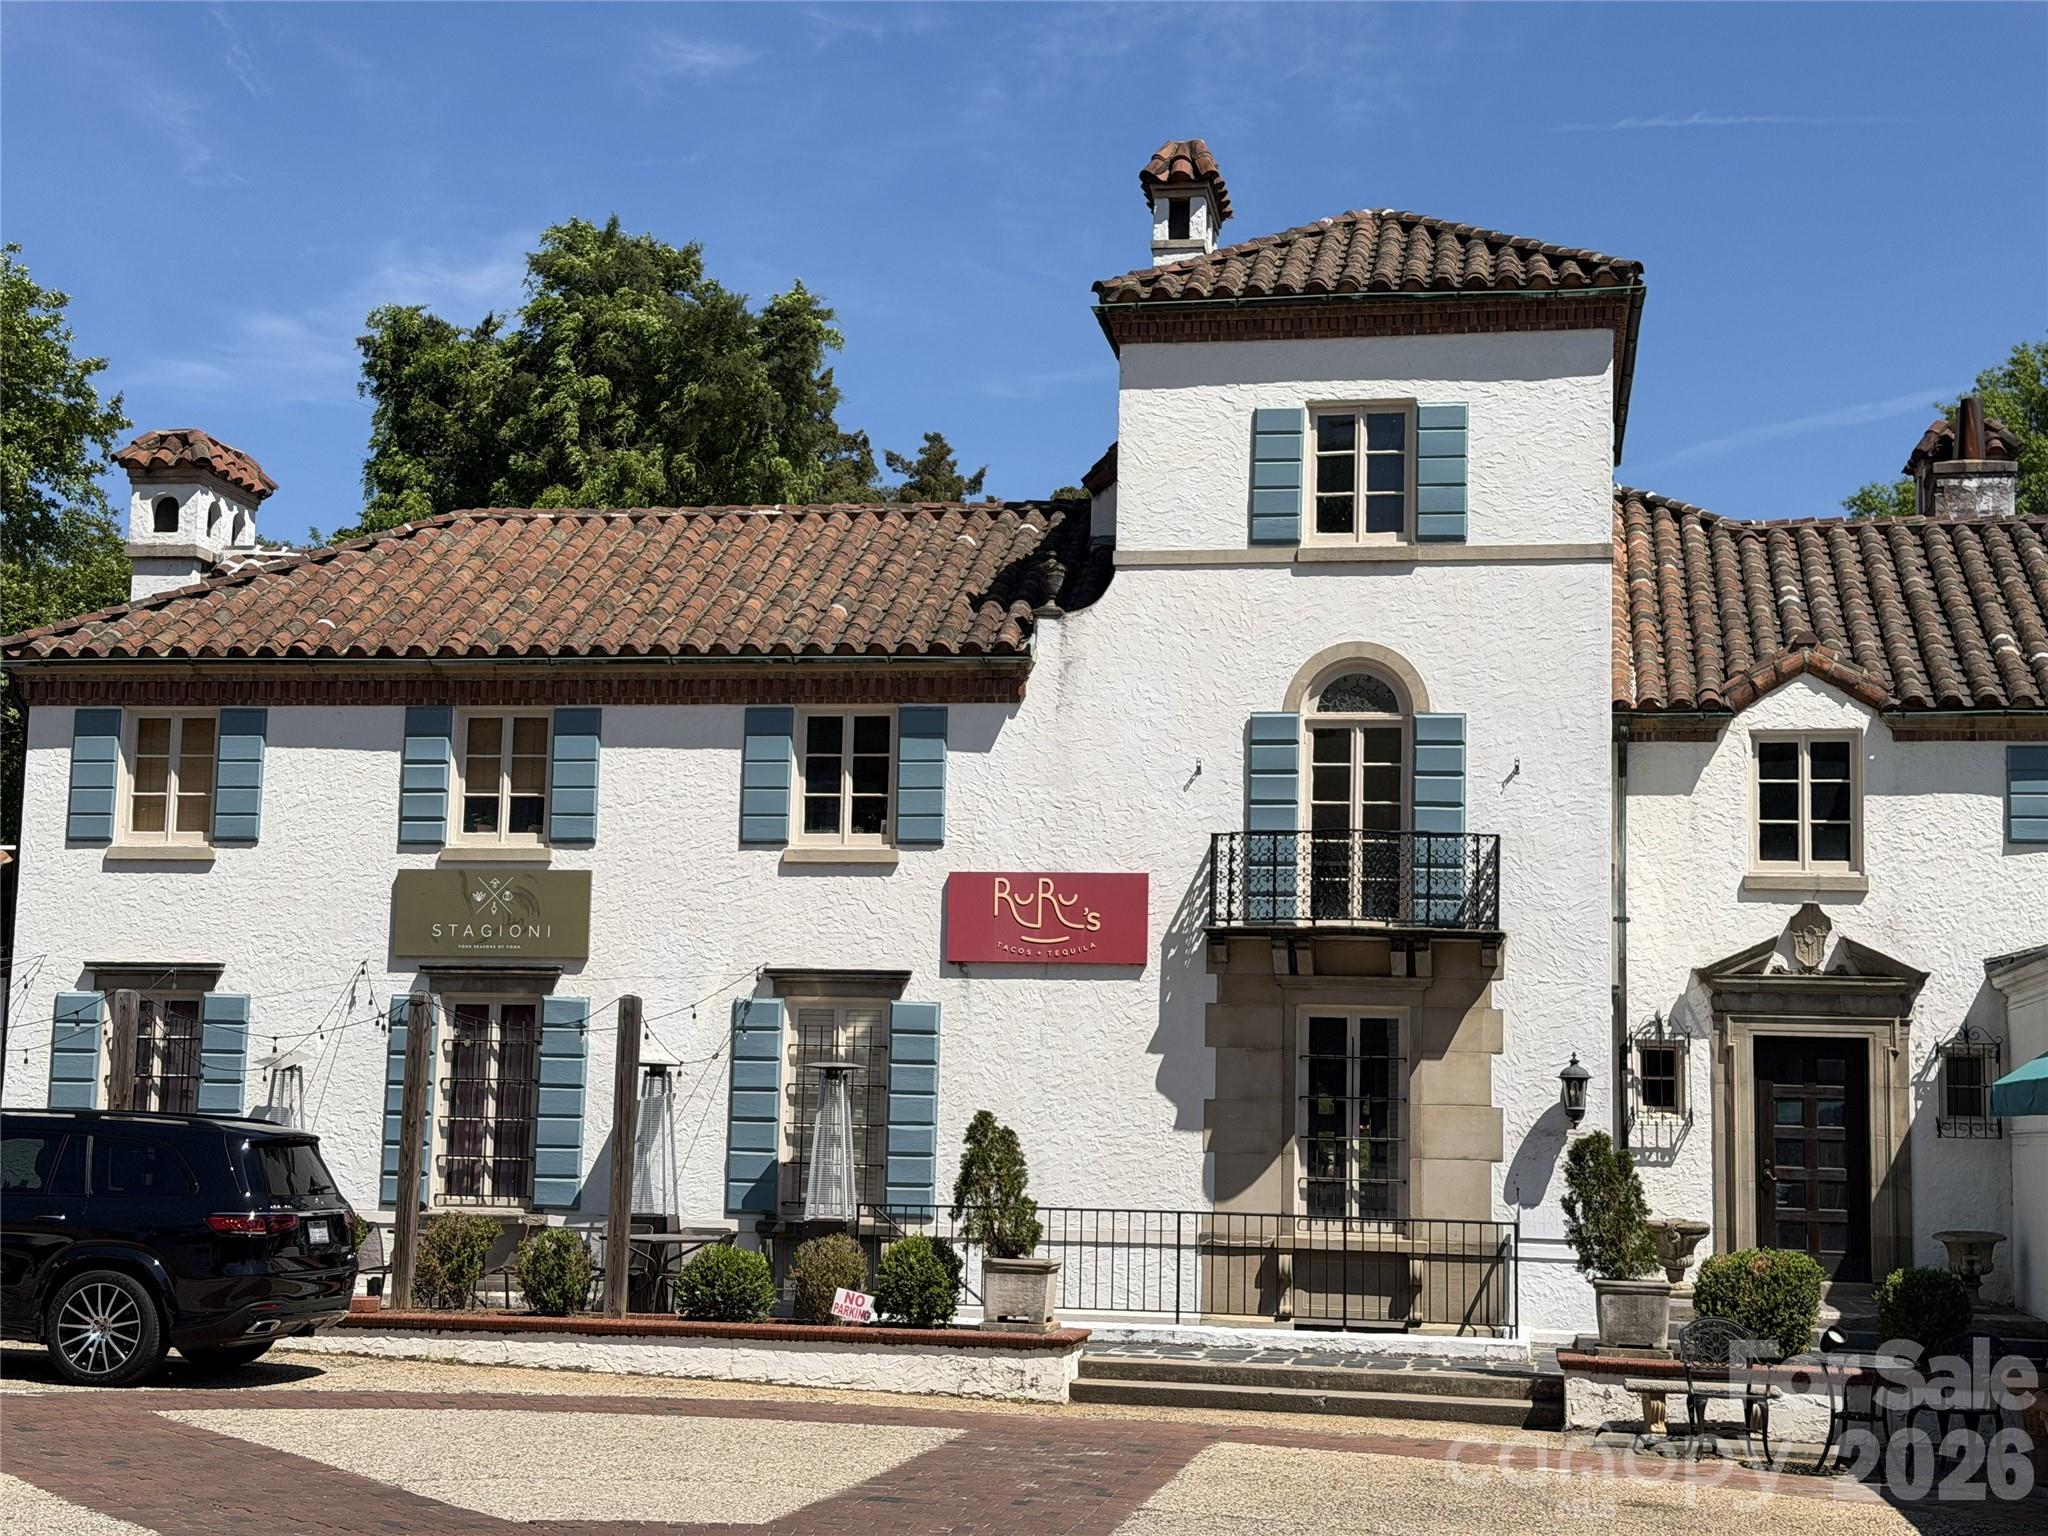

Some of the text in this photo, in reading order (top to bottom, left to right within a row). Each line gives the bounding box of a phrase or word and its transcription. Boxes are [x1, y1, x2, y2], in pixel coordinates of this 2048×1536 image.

[432, 924, 551, 938] STAGIONI
[996, 941, 1032, 956] TACOS
[1047, 942, 1096, 957] TEQUILA
[843, 1292, 866, 1308] NO
[834, 1303, 871, 1321] PARKING
